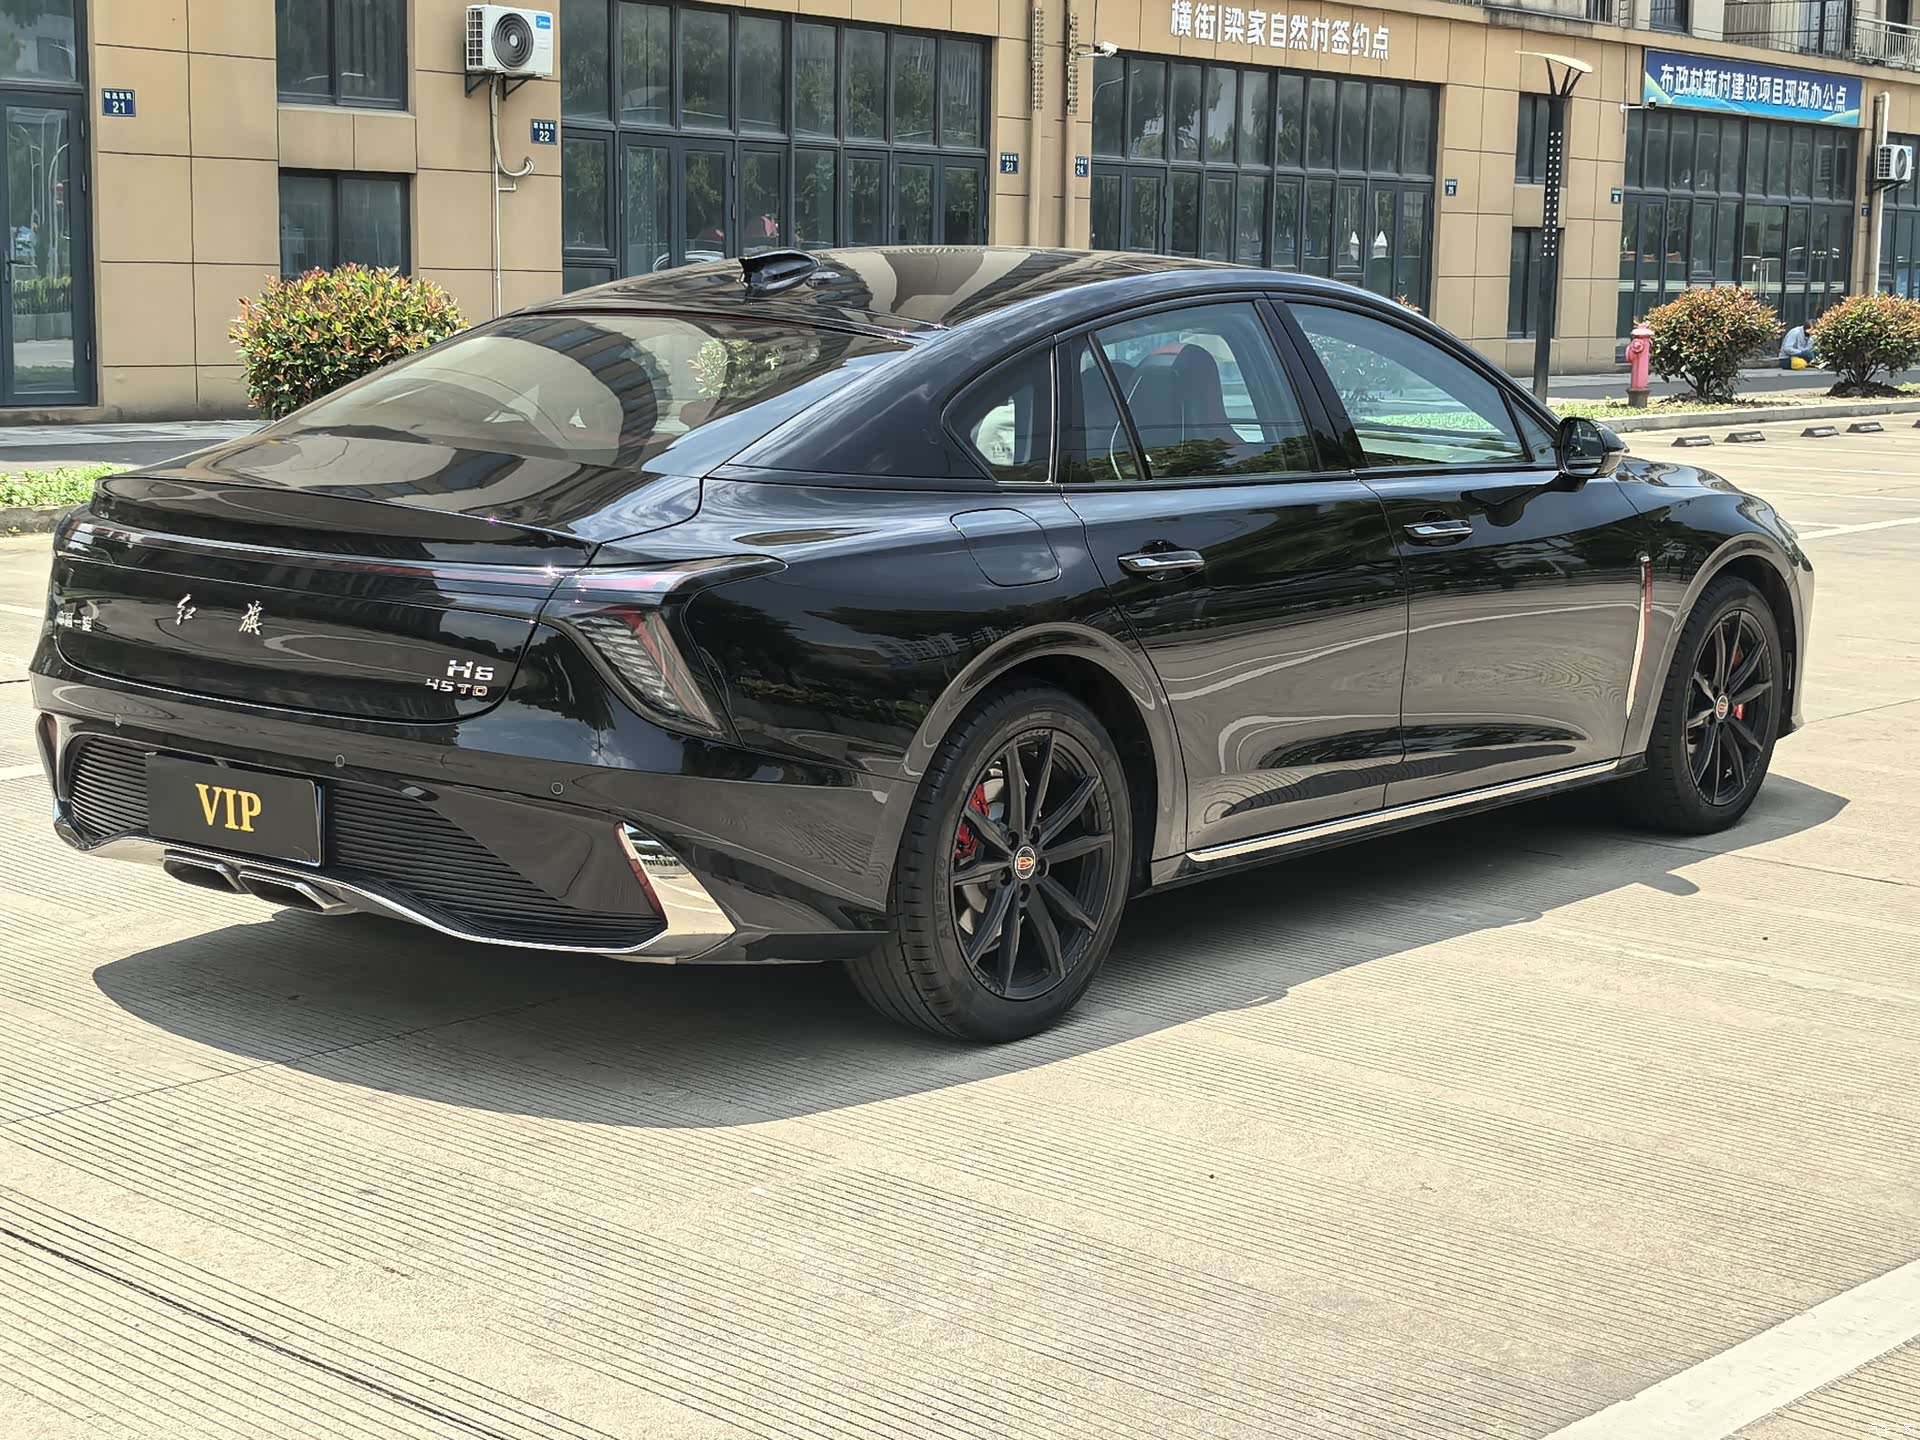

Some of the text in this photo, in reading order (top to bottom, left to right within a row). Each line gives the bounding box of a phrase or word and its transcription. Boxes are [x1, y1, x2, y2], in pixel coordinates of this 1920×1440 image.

[1660, 63, 1847, 113] 布政村新村建设项目现场办公点
[112, 101, 126, 114] 21
[539, 130, 550, 142] 22
[447, 659, 495, 681] H6
[425, 678, 488, 697] 45TD
[195, 783, 262, 832] VIP
